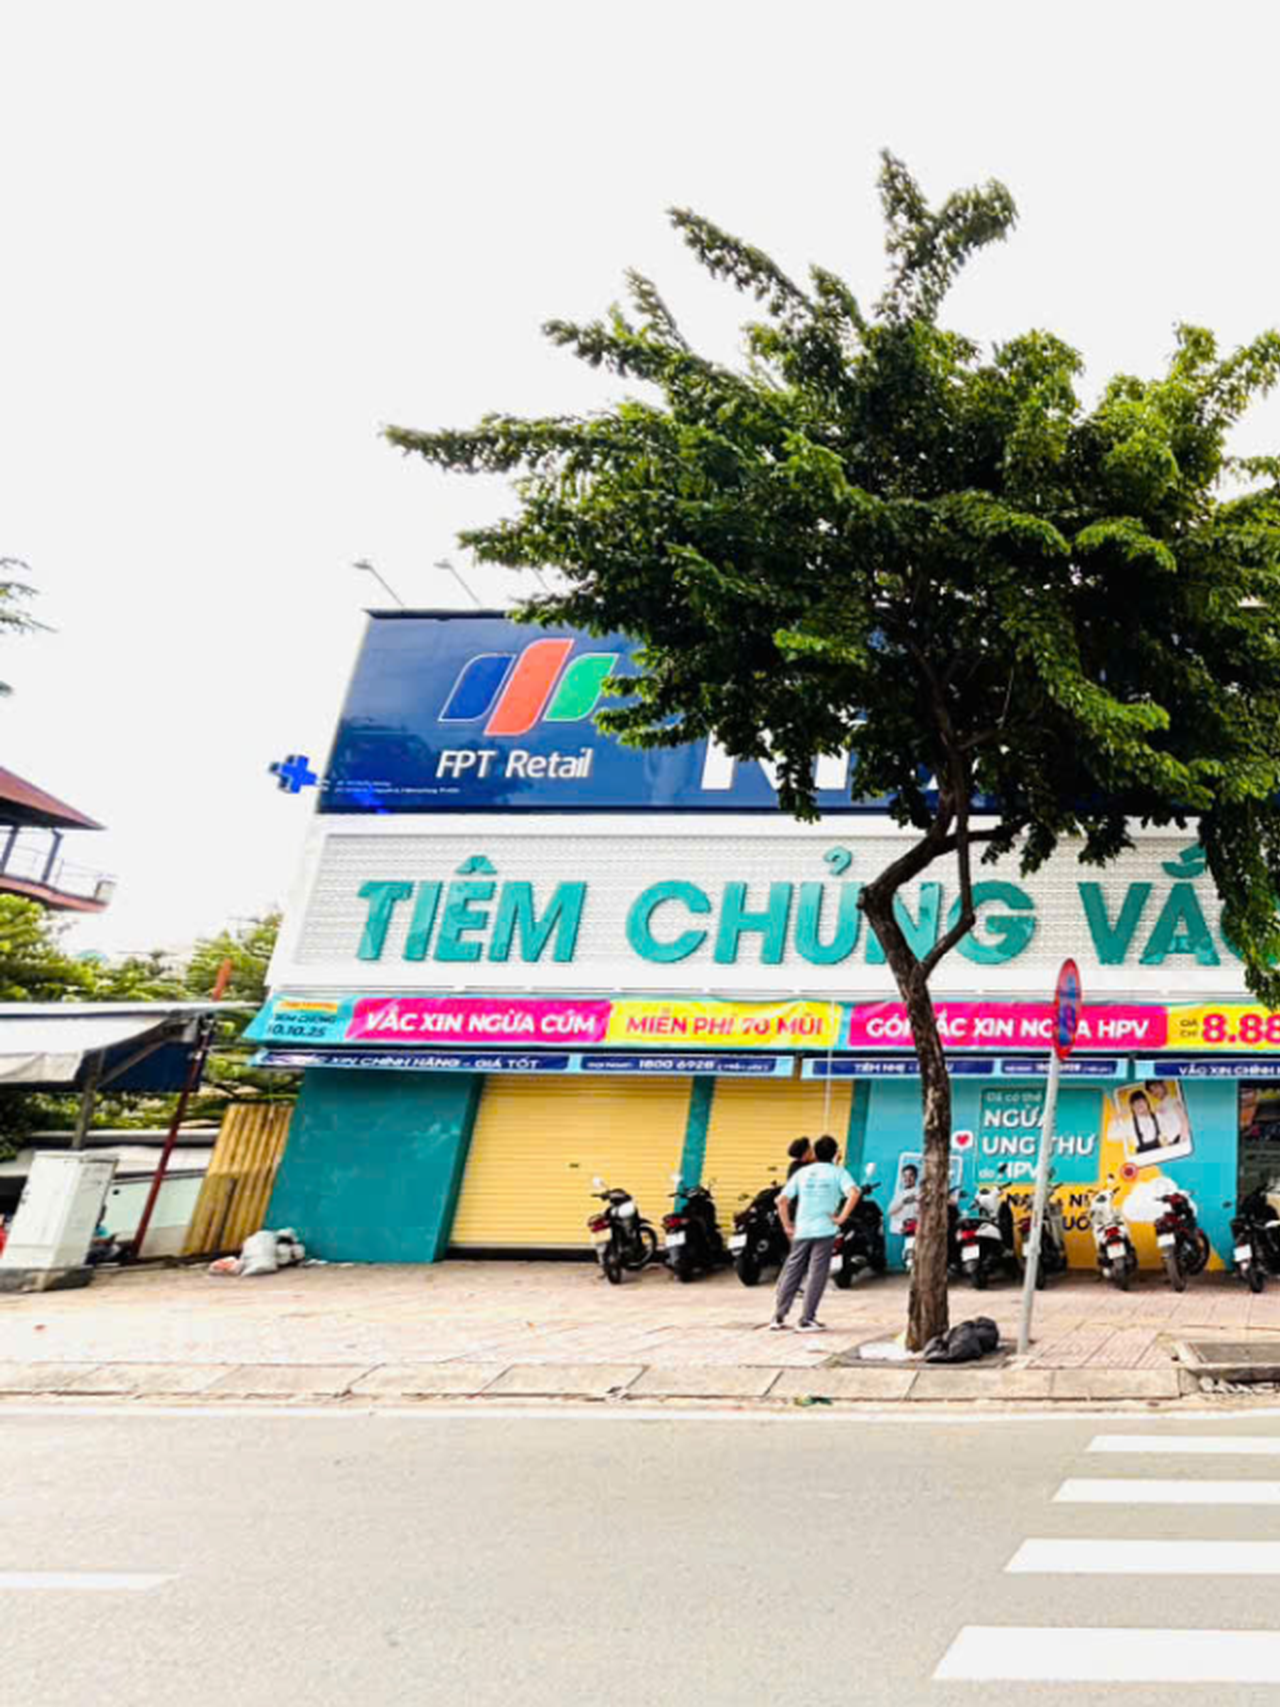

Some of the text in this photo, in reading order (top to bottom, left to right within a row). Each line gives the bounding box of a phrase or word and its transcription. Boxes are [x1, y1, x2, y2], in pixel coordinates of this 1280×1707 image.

[436, 748, 593, 779] FPT Retail
[356, 855, 587, 963] TIÊM
[421, 1012, 463, 1032] XIN
[468, 1008, 535, 1034] NGỪA
[541, 1009, 595, 1034] CÚM
[936, 1009, 967, 1037] ẮC
[973, 1017, 1014, 1038] XIN
[1020, 1017, 1092, 1039] NGA
[1098, 1018, 1150, 1039] HPV
[639, 1059, 673, 1069] 1800
[676, 1059, 714, 1070] 6928
[982, 1136, 1036, 1155] UNG
